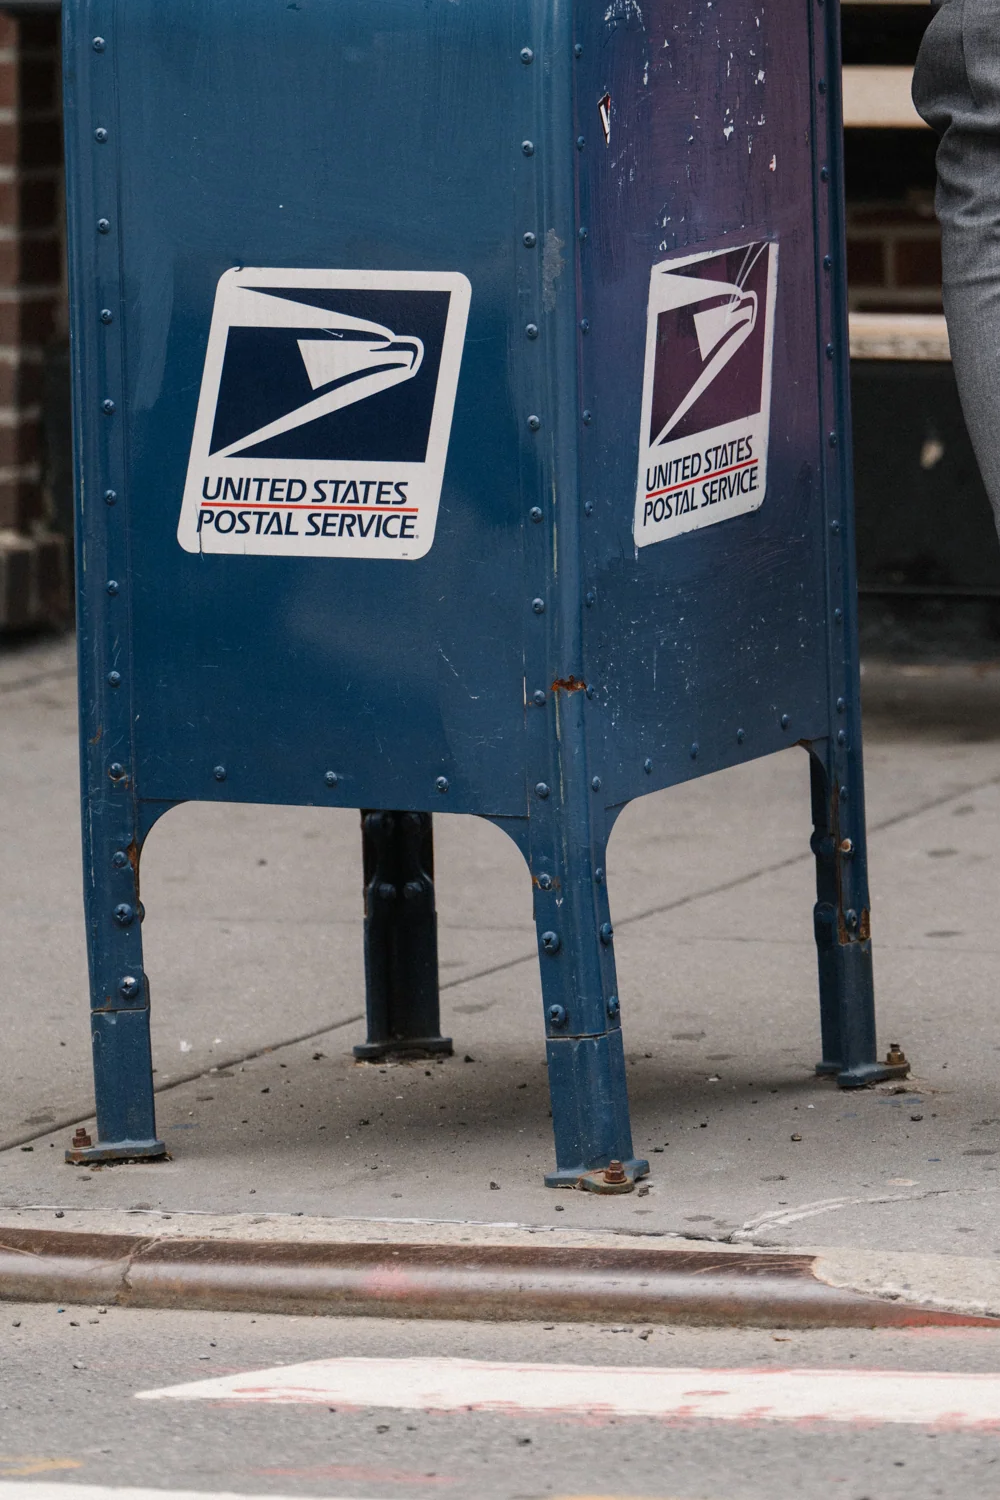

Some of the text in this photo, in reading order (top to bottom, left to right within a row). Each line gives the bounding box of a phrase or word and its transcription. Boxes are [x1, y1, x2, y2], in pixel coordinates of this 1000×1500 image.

[647, 435, 752, 491] UNITED STATES
[203, 477, 409, 505] UNITED STATES
[644, 466, 759, 526] POSTAL SERVICE
[197, 510, 418, 539] POSTAL SERVICE
